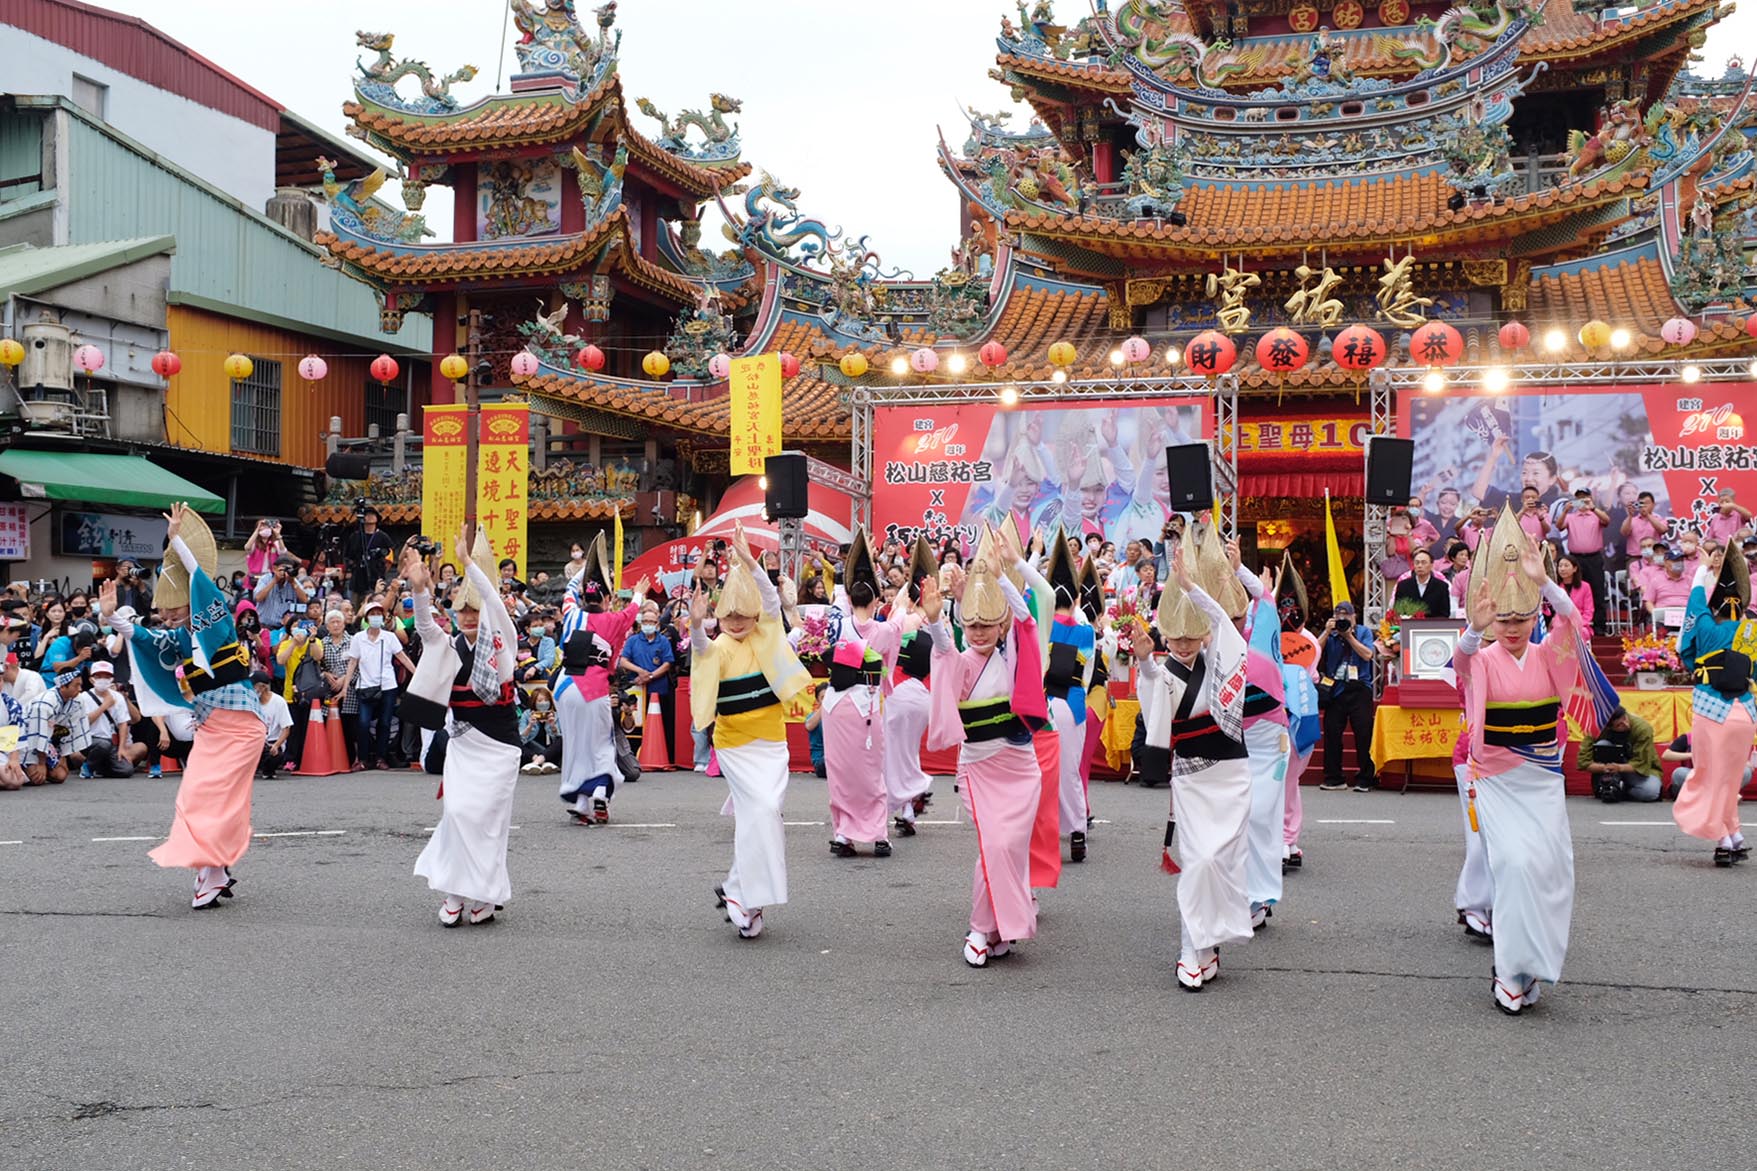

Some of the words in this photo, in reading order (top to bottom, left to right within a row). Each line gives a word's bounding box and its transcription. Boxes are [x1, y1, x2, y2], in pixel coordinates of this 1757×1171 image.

[1644, 446, 1757, 470] 松山慈祐
[885, 461, 993, 483] 松山慈祐宮
